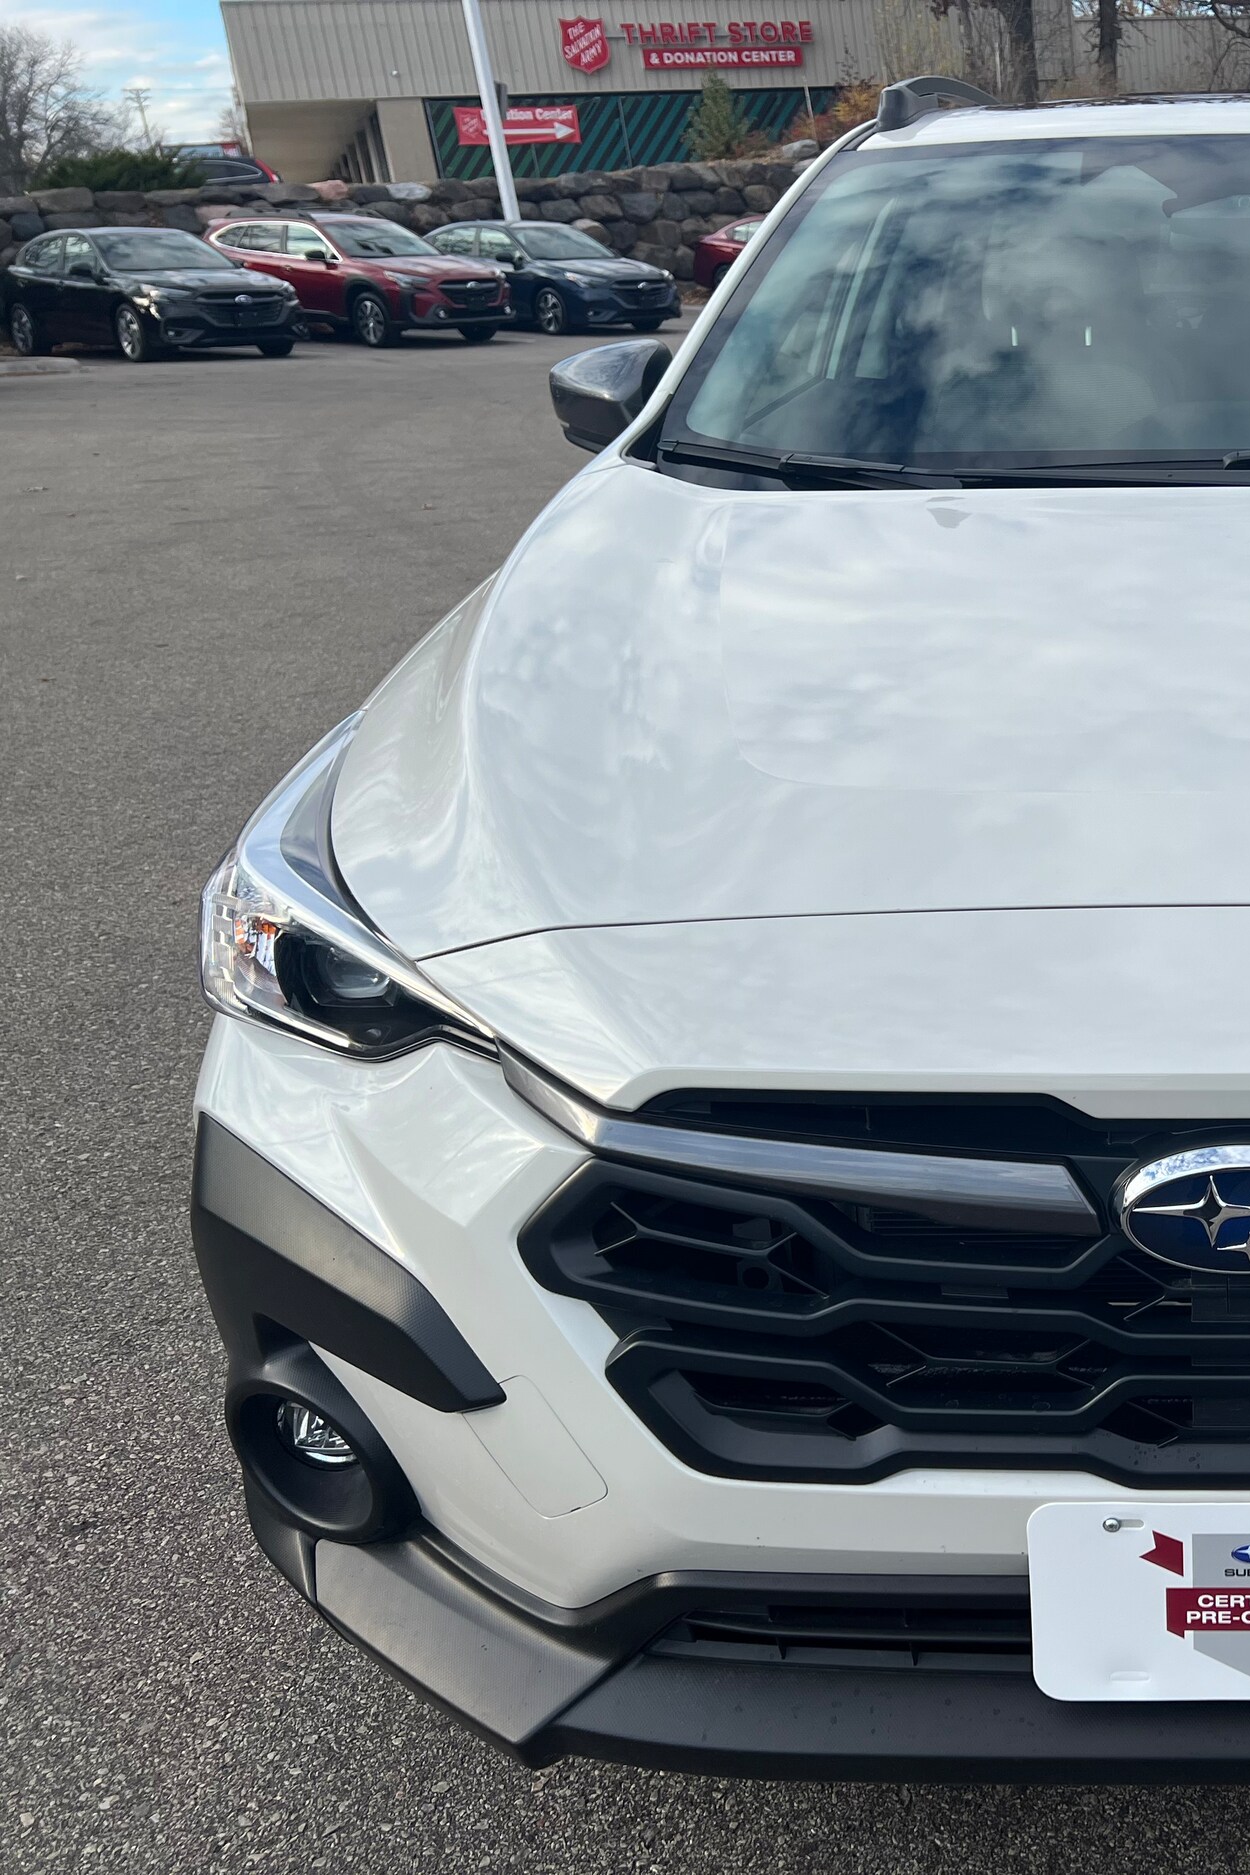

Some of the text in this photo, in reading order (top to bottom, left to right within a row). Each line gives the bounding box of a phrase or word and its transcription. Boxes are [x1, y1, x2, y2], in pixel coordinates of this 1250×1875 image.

[564, 23, 602, 59] SALVATION
[567, 21, 585, 40] THE
[619, 20, 814, 45] THRIFT STORE
[580, 39, 602, 66] ARMY
[649, 49, 796, 64] & DONATION CENTER
[535, 107, 573, 120] Center
